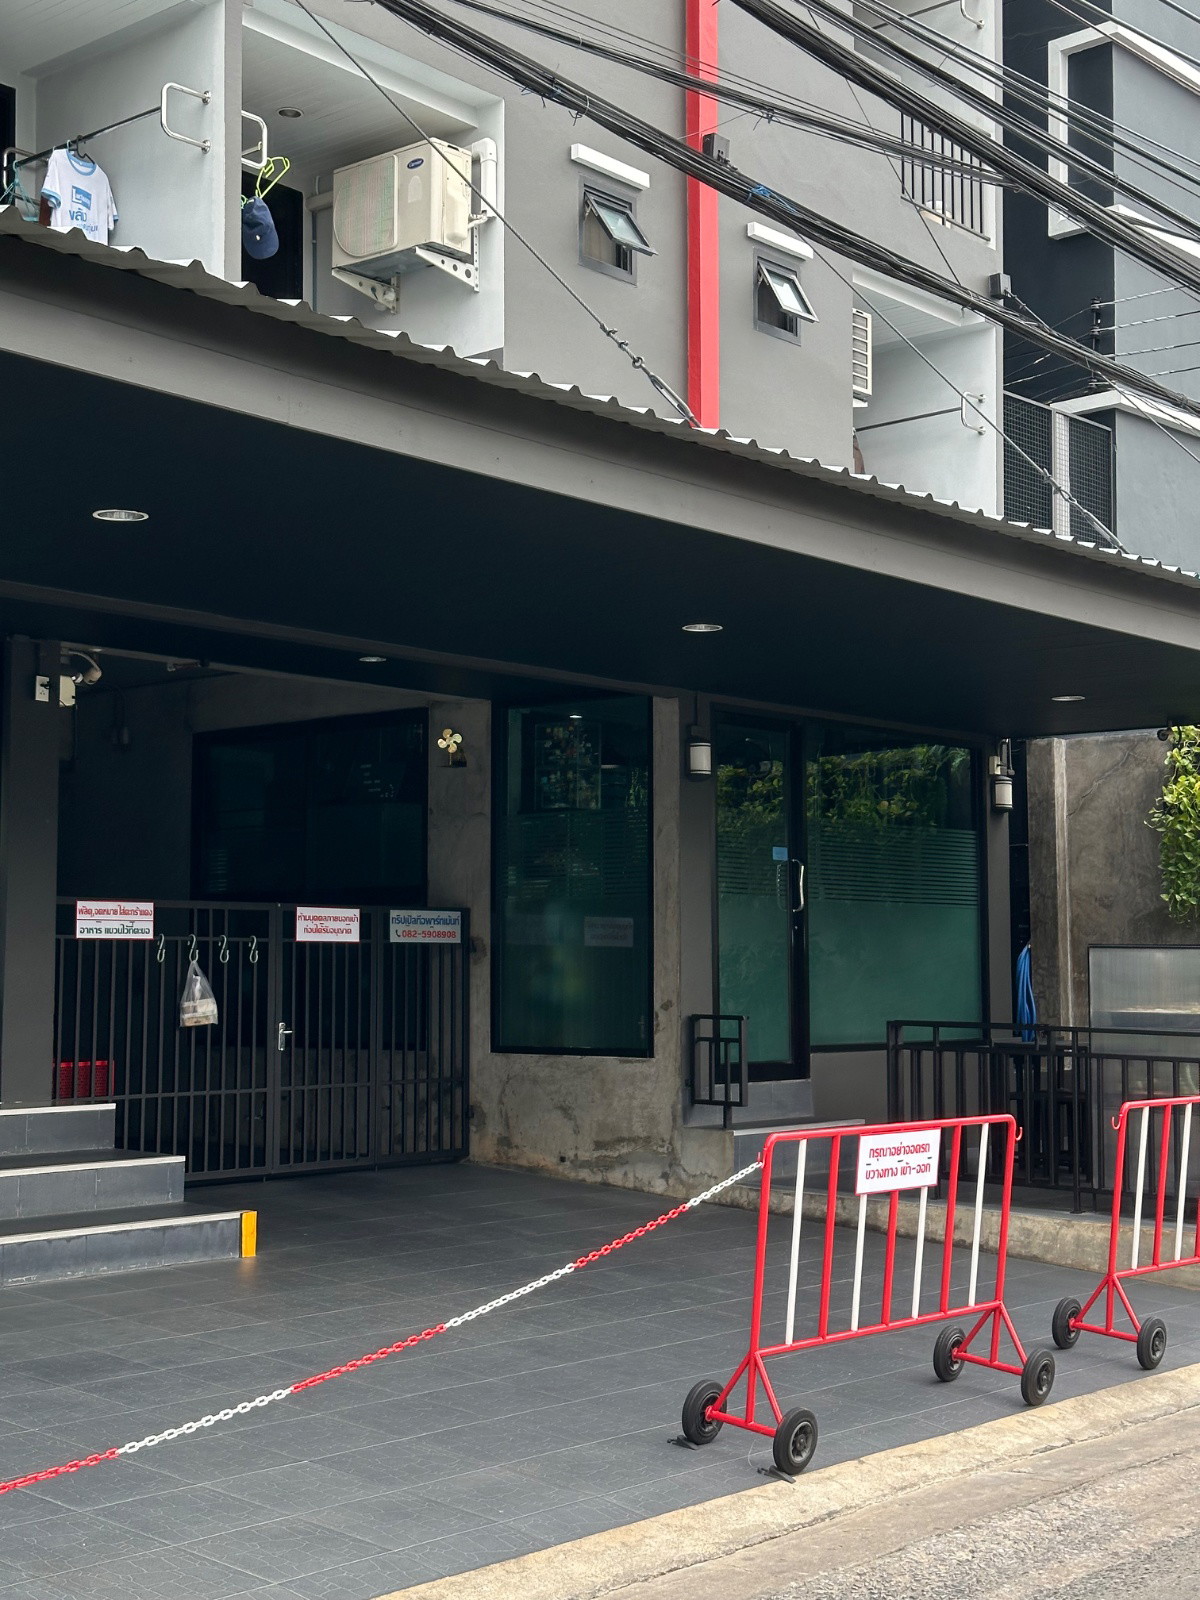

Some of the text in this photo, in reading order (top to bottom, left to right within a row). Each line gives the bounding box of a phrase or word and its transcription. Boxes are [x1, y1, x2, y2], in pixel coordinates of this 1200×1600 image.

[402, 929, 456, 938] 082-5908908
[869, 1142, 931, 1161] กรุณาอย่าจอดรถ
[866, 1162, 931, 1179] ขวางทาง เข้า-ออก
